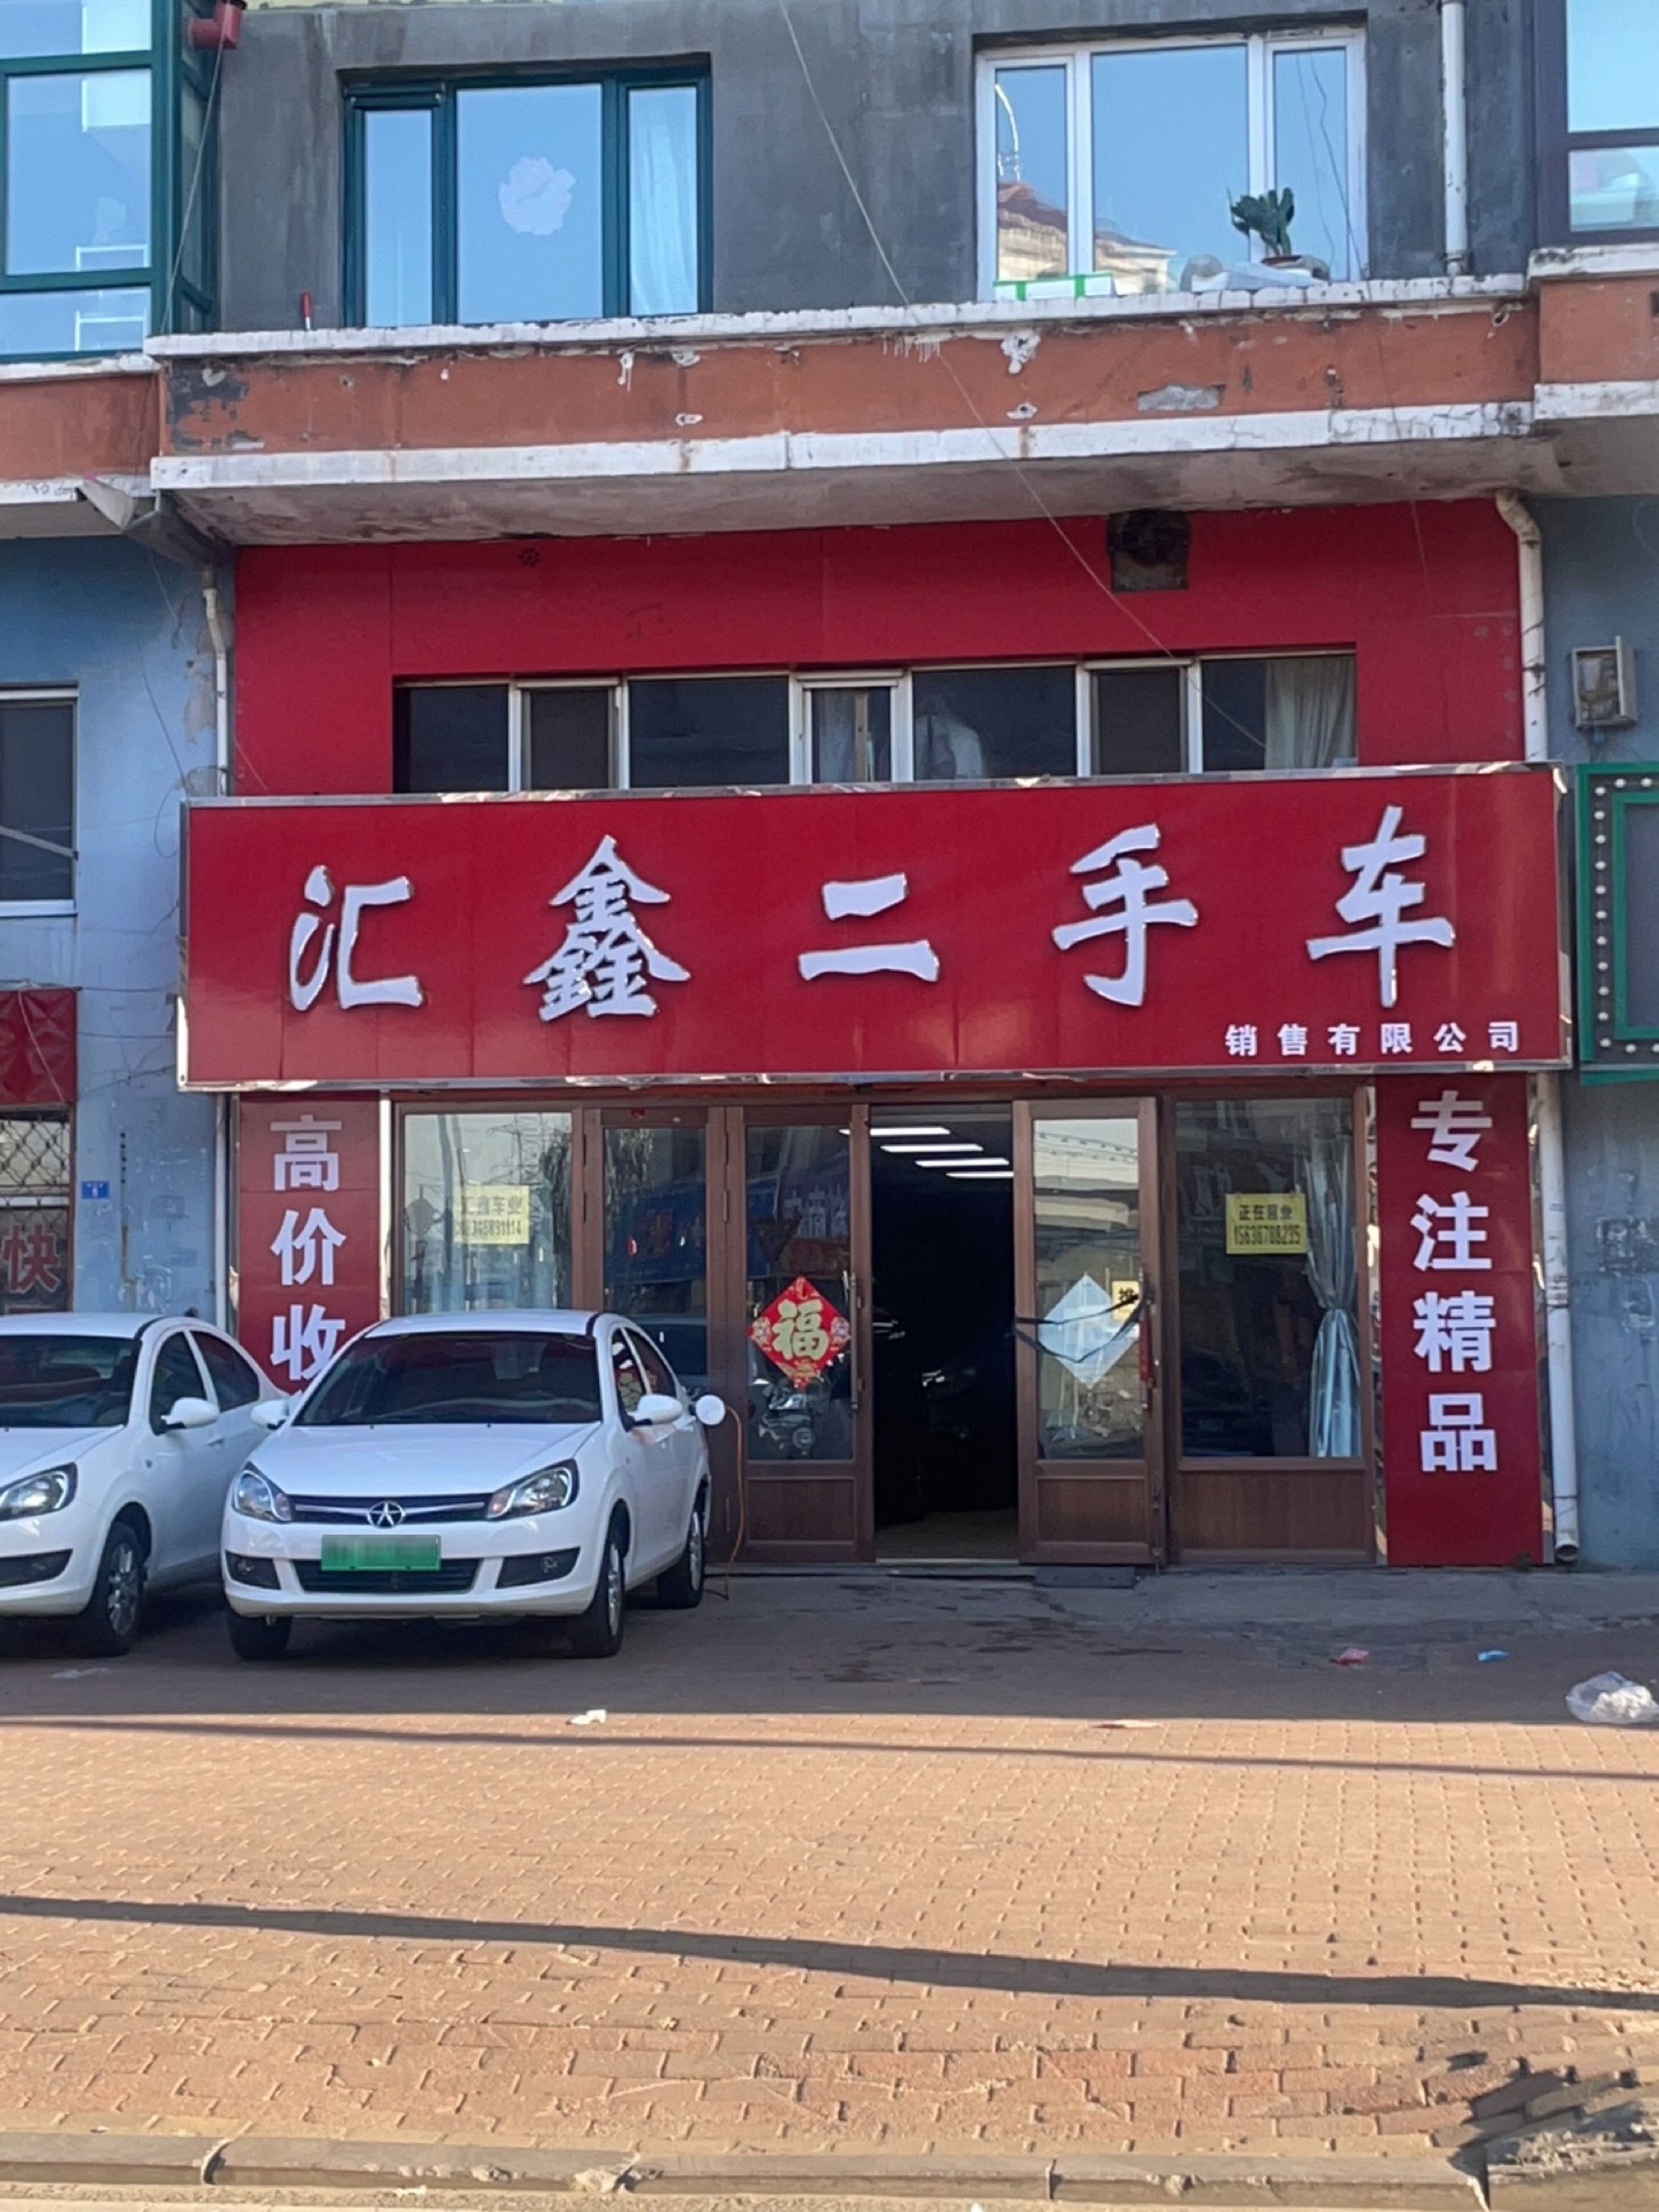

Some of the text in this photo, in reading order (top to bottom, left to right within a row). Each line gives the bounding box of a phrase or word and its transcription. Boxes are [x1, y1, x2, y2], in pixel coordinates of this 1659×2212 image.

[289, 805, 1455, 1022] 汇鑫二手车
[1225, 1022, 1519, 1057] 销售有限公司
[270, 1115, 346, 1384] 高价收
[772, 1299, 830, 1360] 福
[1411, 1090, 1498, 1472] 专注精品
